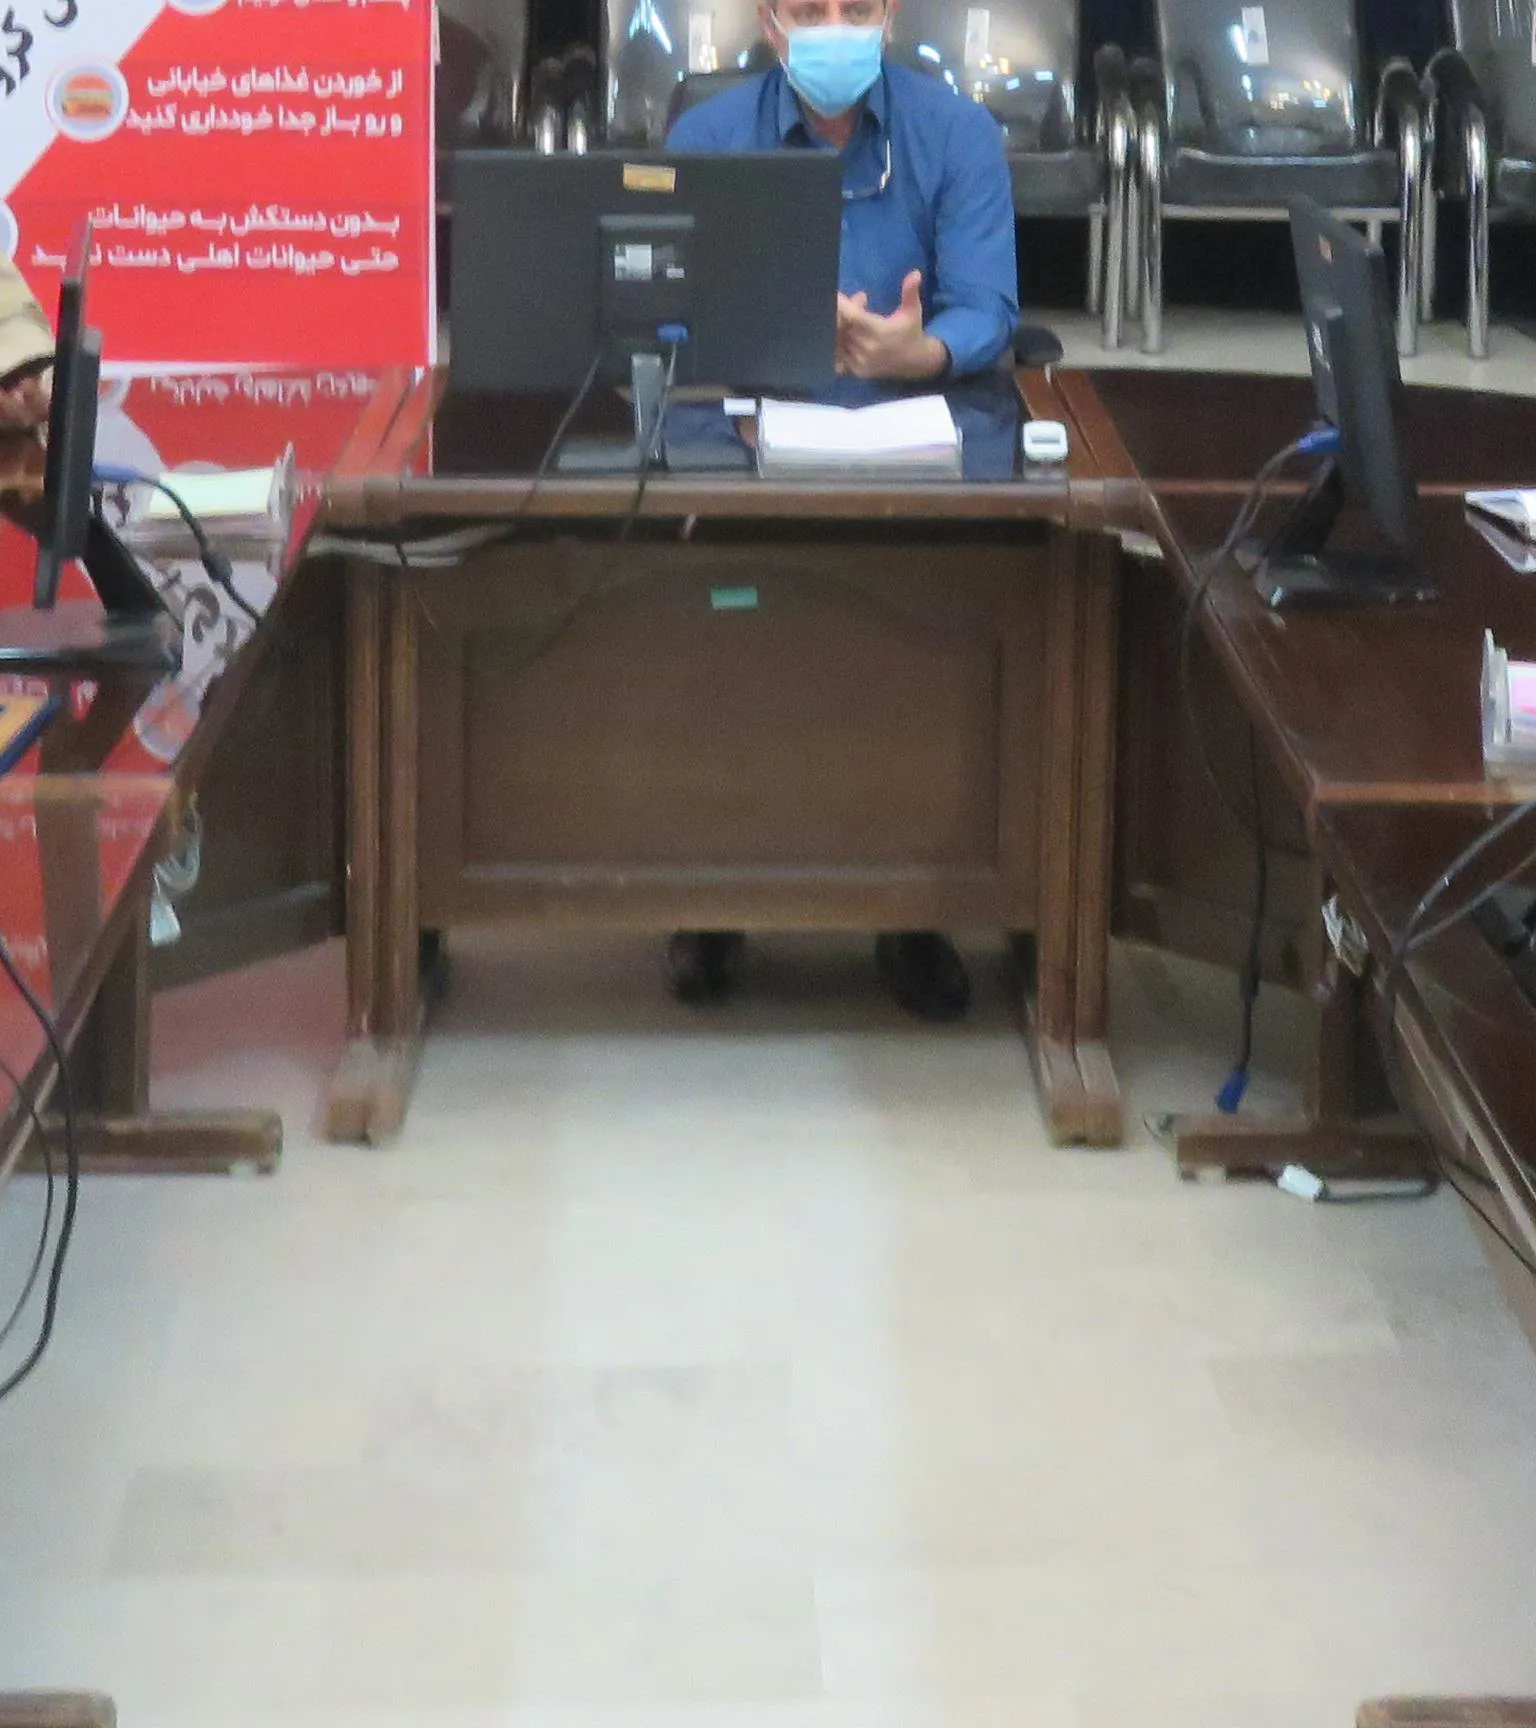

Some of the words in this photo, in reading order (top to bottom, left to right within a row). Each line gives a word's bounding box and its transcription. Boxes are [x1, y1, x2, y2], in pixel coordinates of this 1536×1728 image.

[148, 66, 227, 97] خیابانی
[231, 66, 309, 97] غذاهای
[314, 69, 382, 98] خوردن
[386, 68, 402, 98] از
[125, 100, 177, 133] کنید
[181, 104, 273, 135] خودداری
[279, 105, 316, 136] جدا
[391, 114, 402, 136] و
[88, 204, 186, 235] حیوانات
[190, 210, 227, 235] به
[230, 204, 326, 236] دستکش
[330, 212, 399, 237] بدون
[108, 246, 171, 266] دست
[177, 242, 240, 273] اهلی
[246, 244, 334, 275] حیوانات
[341, 247, 398, 275] حتی
